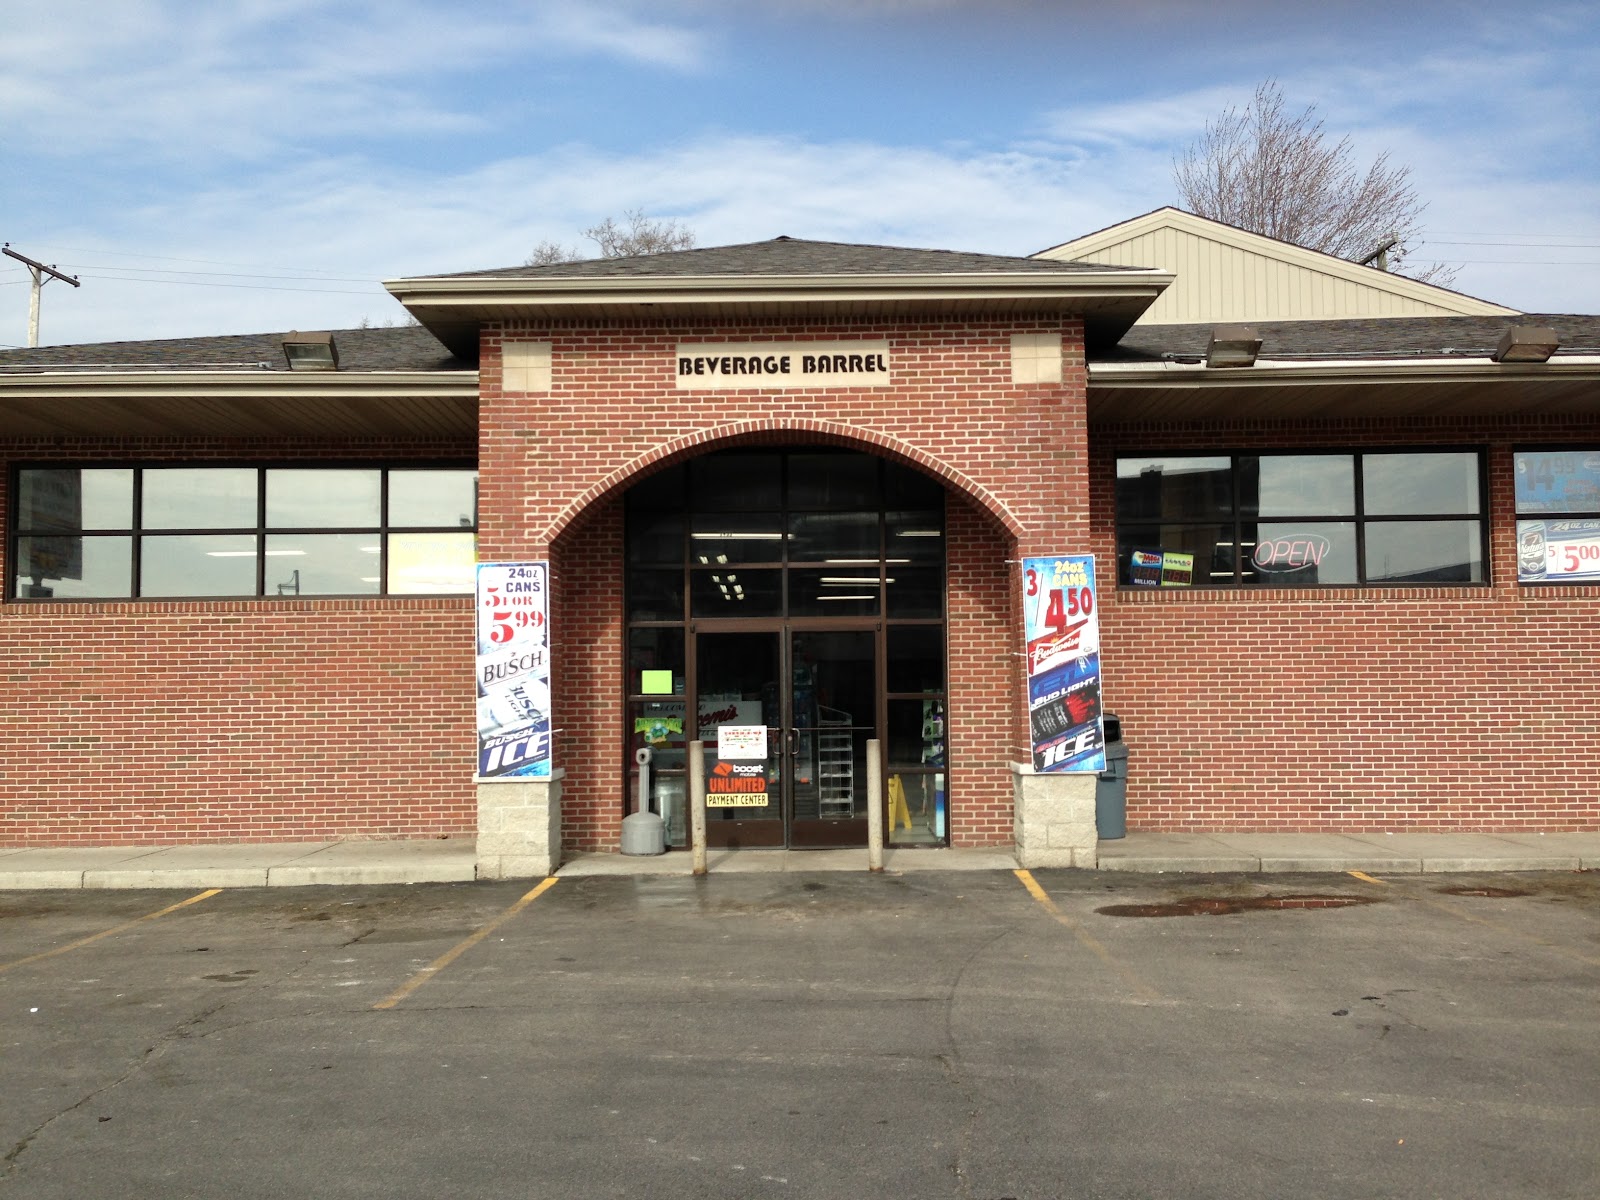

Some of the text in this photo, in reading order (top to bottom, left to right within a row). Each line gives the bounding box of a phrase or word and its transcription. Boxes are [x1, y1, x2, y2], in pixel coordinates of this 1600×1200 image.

[679, 354, 887, 375] BEVERAGE BARREL
[1254, 541, 1325, 566] OPEN
[506, 581, 541, 593] CANS
[1052, 573, 1088, 587] CANS
[1134, 578, 1157, 586] MILLION
[483, 650, 543, 684] BUSCH
[1034, 676, 1096, 706] BUD LIGHT
[483, 727, 535, 750] BUSCH
[1043, 728, 1096, 768] ICE
[486, 732, 549, 772] ICE
[732, 764, 764, 773] boost
[709, 777, 766, 793] UNLIMITED
[708, 794, 766, 805] PAYMENT CENTER
